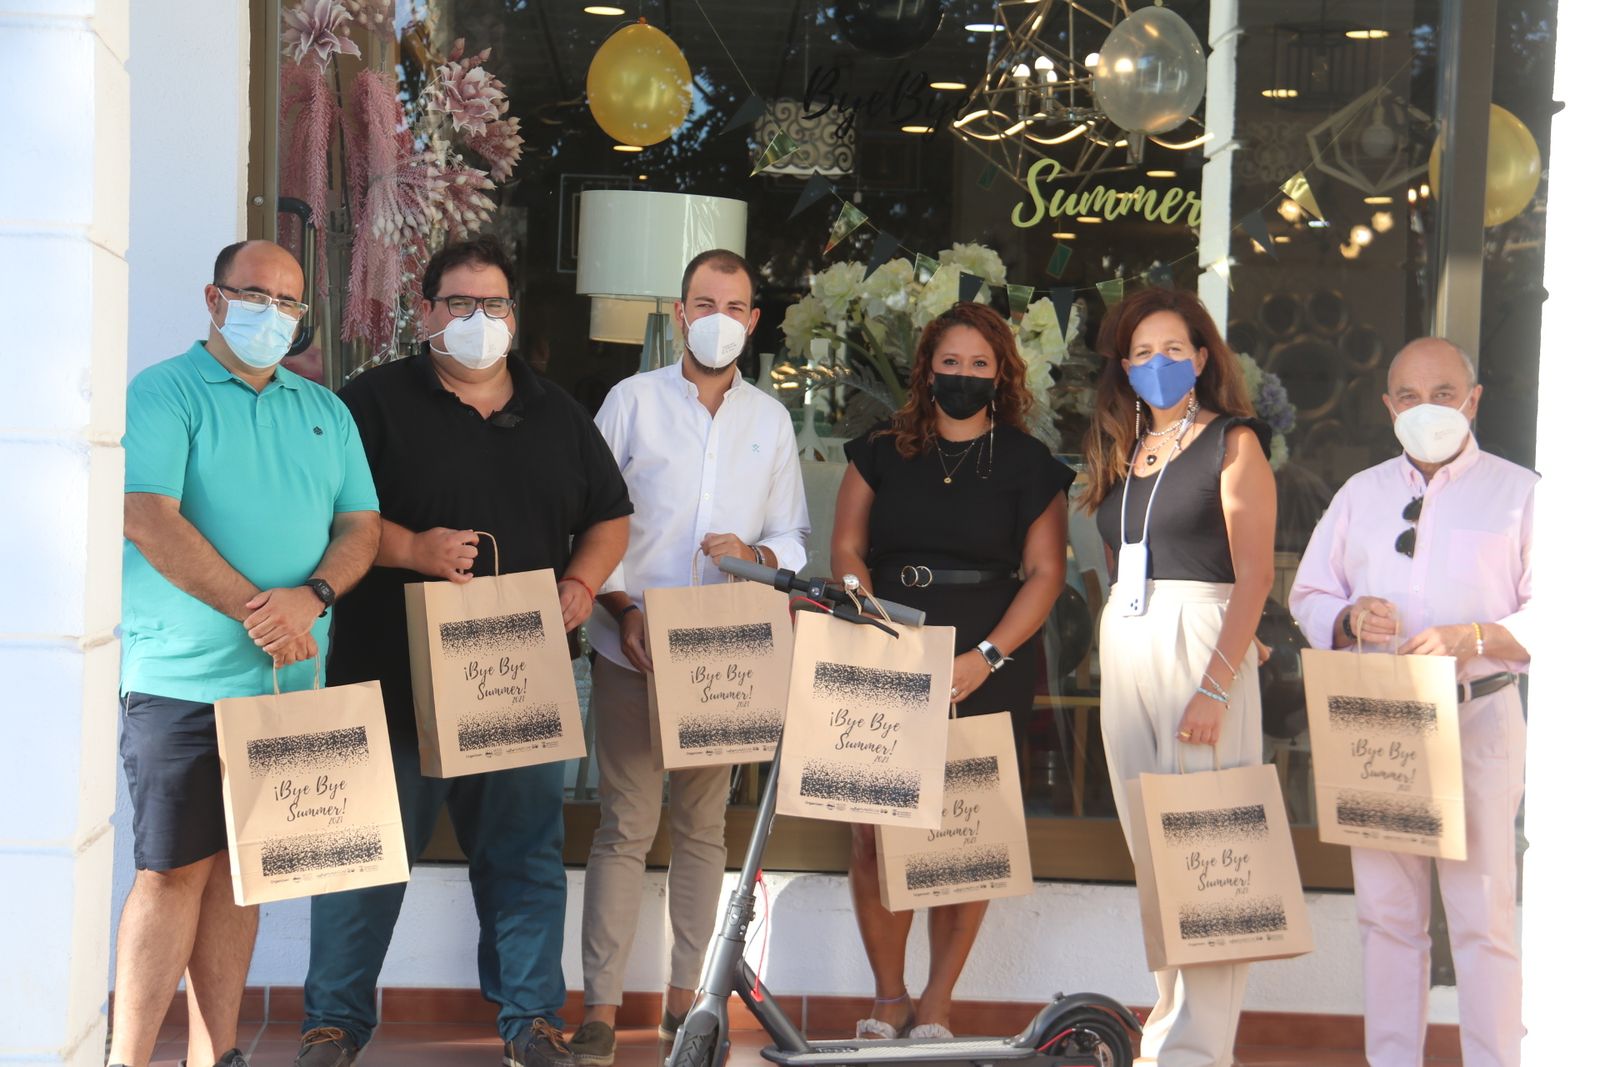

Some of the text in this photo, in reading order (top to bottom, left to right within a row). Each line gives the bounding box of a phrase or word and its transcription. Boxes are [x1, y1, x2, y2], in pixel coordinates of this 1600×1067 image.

[1011, 158, 1201, 228] Summer
[500, 656, 527, 681] Bye
[727, 663, 754, 686] Bye
[477, 677, 528, 701] Summer!
[701, 684, 753, 704] Summer!
[870, 712, 901, 739] Bye
[835, 732, 898, 756] Summer!
[1389, 740, 1417, 768] Bye
[316, 774, 347, 800] Bye
[287, 797, 347, 822] Summer!
[953, 799, 981, 822] Bye
[928, 820, 981, 842] Summer!
[1222, 848, 1249, 873] Bye
[1197, 869, 1252, 892] Summer!
